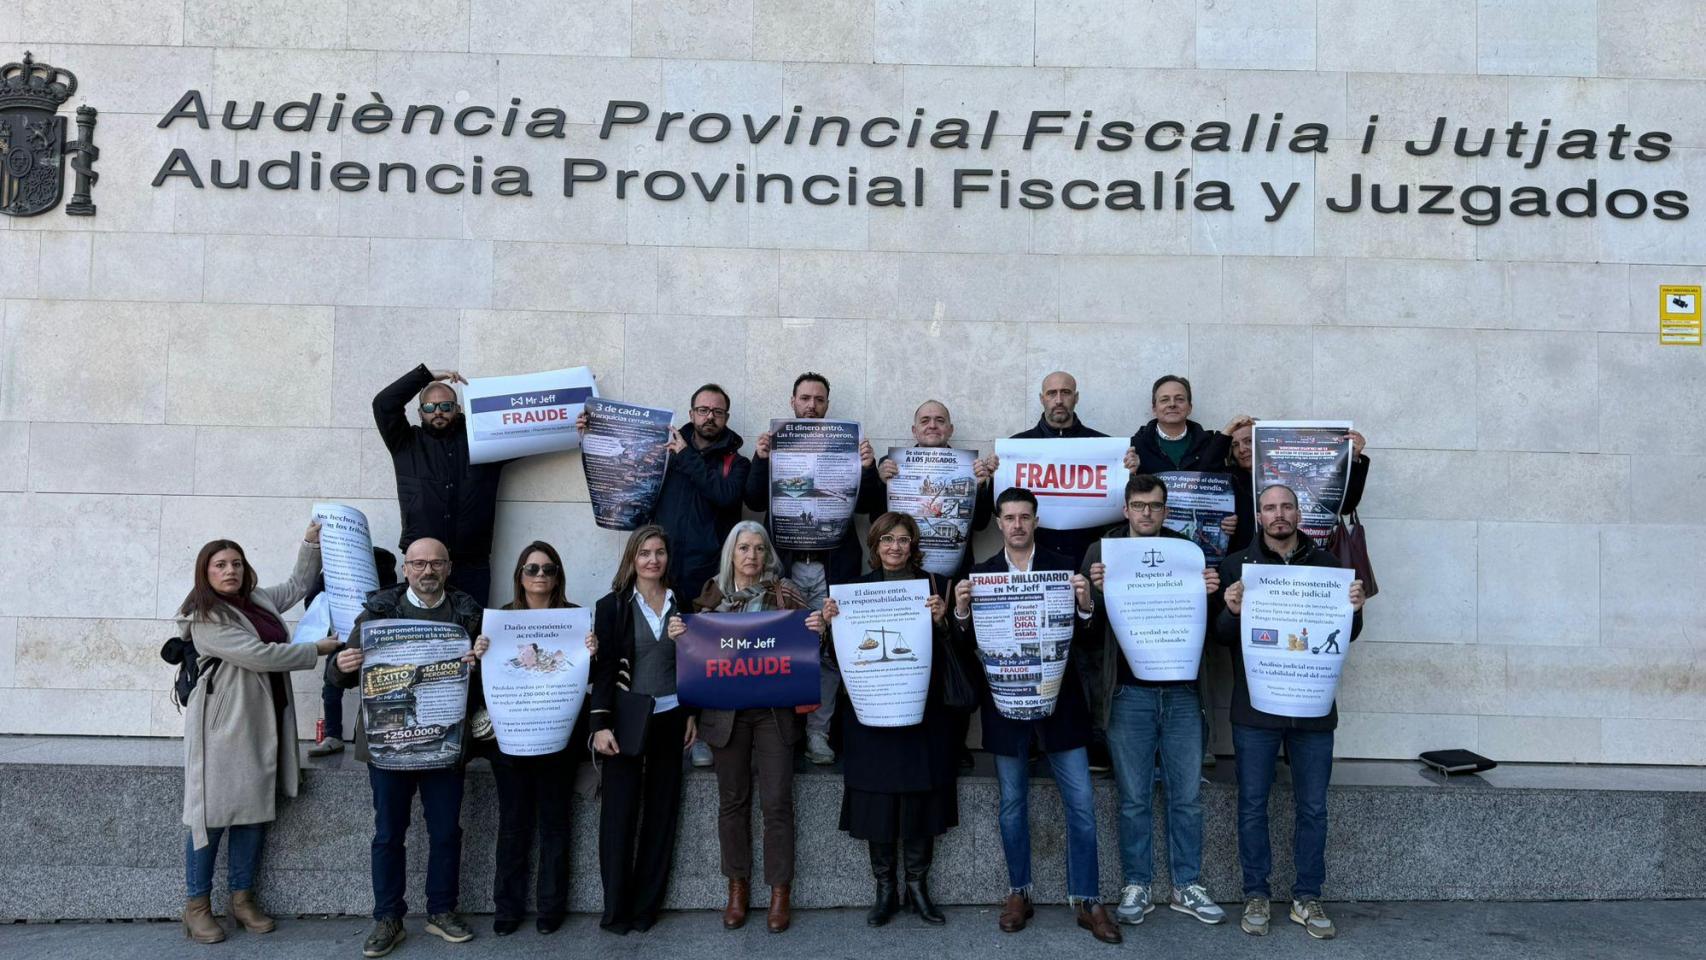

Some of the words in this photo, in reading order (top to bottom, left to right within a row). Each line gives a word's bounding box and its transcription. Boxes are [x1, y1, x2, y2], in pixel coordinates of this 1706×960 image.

[156, 88, 567, 140] Audiència
[599, 100, 1000, 152] Provincial
[1022, 110, 1329, 158] Fiscalia
[1360, 114, 1380, 156] i
[1404, 116, 1673, 170] Jutjats
[151, 148, 534, 198] Audiencia
[563, 157, 925, 210] Provincial
[953, 168, 1235, 212] Fiscalía
[1260, 181, 1301, 224] y
[1325, 174, 1690, 227] Juzgados
[526, 396, 537, 405] Mr
[539, 394, 556, 404] Jeff
[596, 403, 602, 411] 3
[604, 404, 617, 413] de
[618, 407, 640, 417] cada
[643, 410, 650, 418] 4
[502, 408, 568, 425] FRAUDE
[590, 412, 627, 422] franquicias
[1015, 463, 1108, 490] FRAUDE
[972, 576, 1009, 586] FRAUDE
[1011, 572, 1069, 583] MILLONARIO
[1136, 572, 1164, 580] Respeto
[1128, 582, 1156, 590] proceso
[1156, 580, 1183, 588] judicial
[1259, 577, 1291, 586] Modelo
[1292, 579, 1342, 588] insostenible
[1006, 585, 1019, 593] Mr
[1022, 584, 1041, 592] Jeff
[852, 594, 914, 606] responsabilidades,
[1301, 590, 1331, 599] judicial
[737, 639, 752, 649] Mr
[754, 638, 776, 649] Jeff
[422, 662, 460, 673] +121.000
[706, 656, 791, 678] FRAUDE
[1283, 662, 1306, 670] judicial
[384, 726, 440, 740] +250.000€
